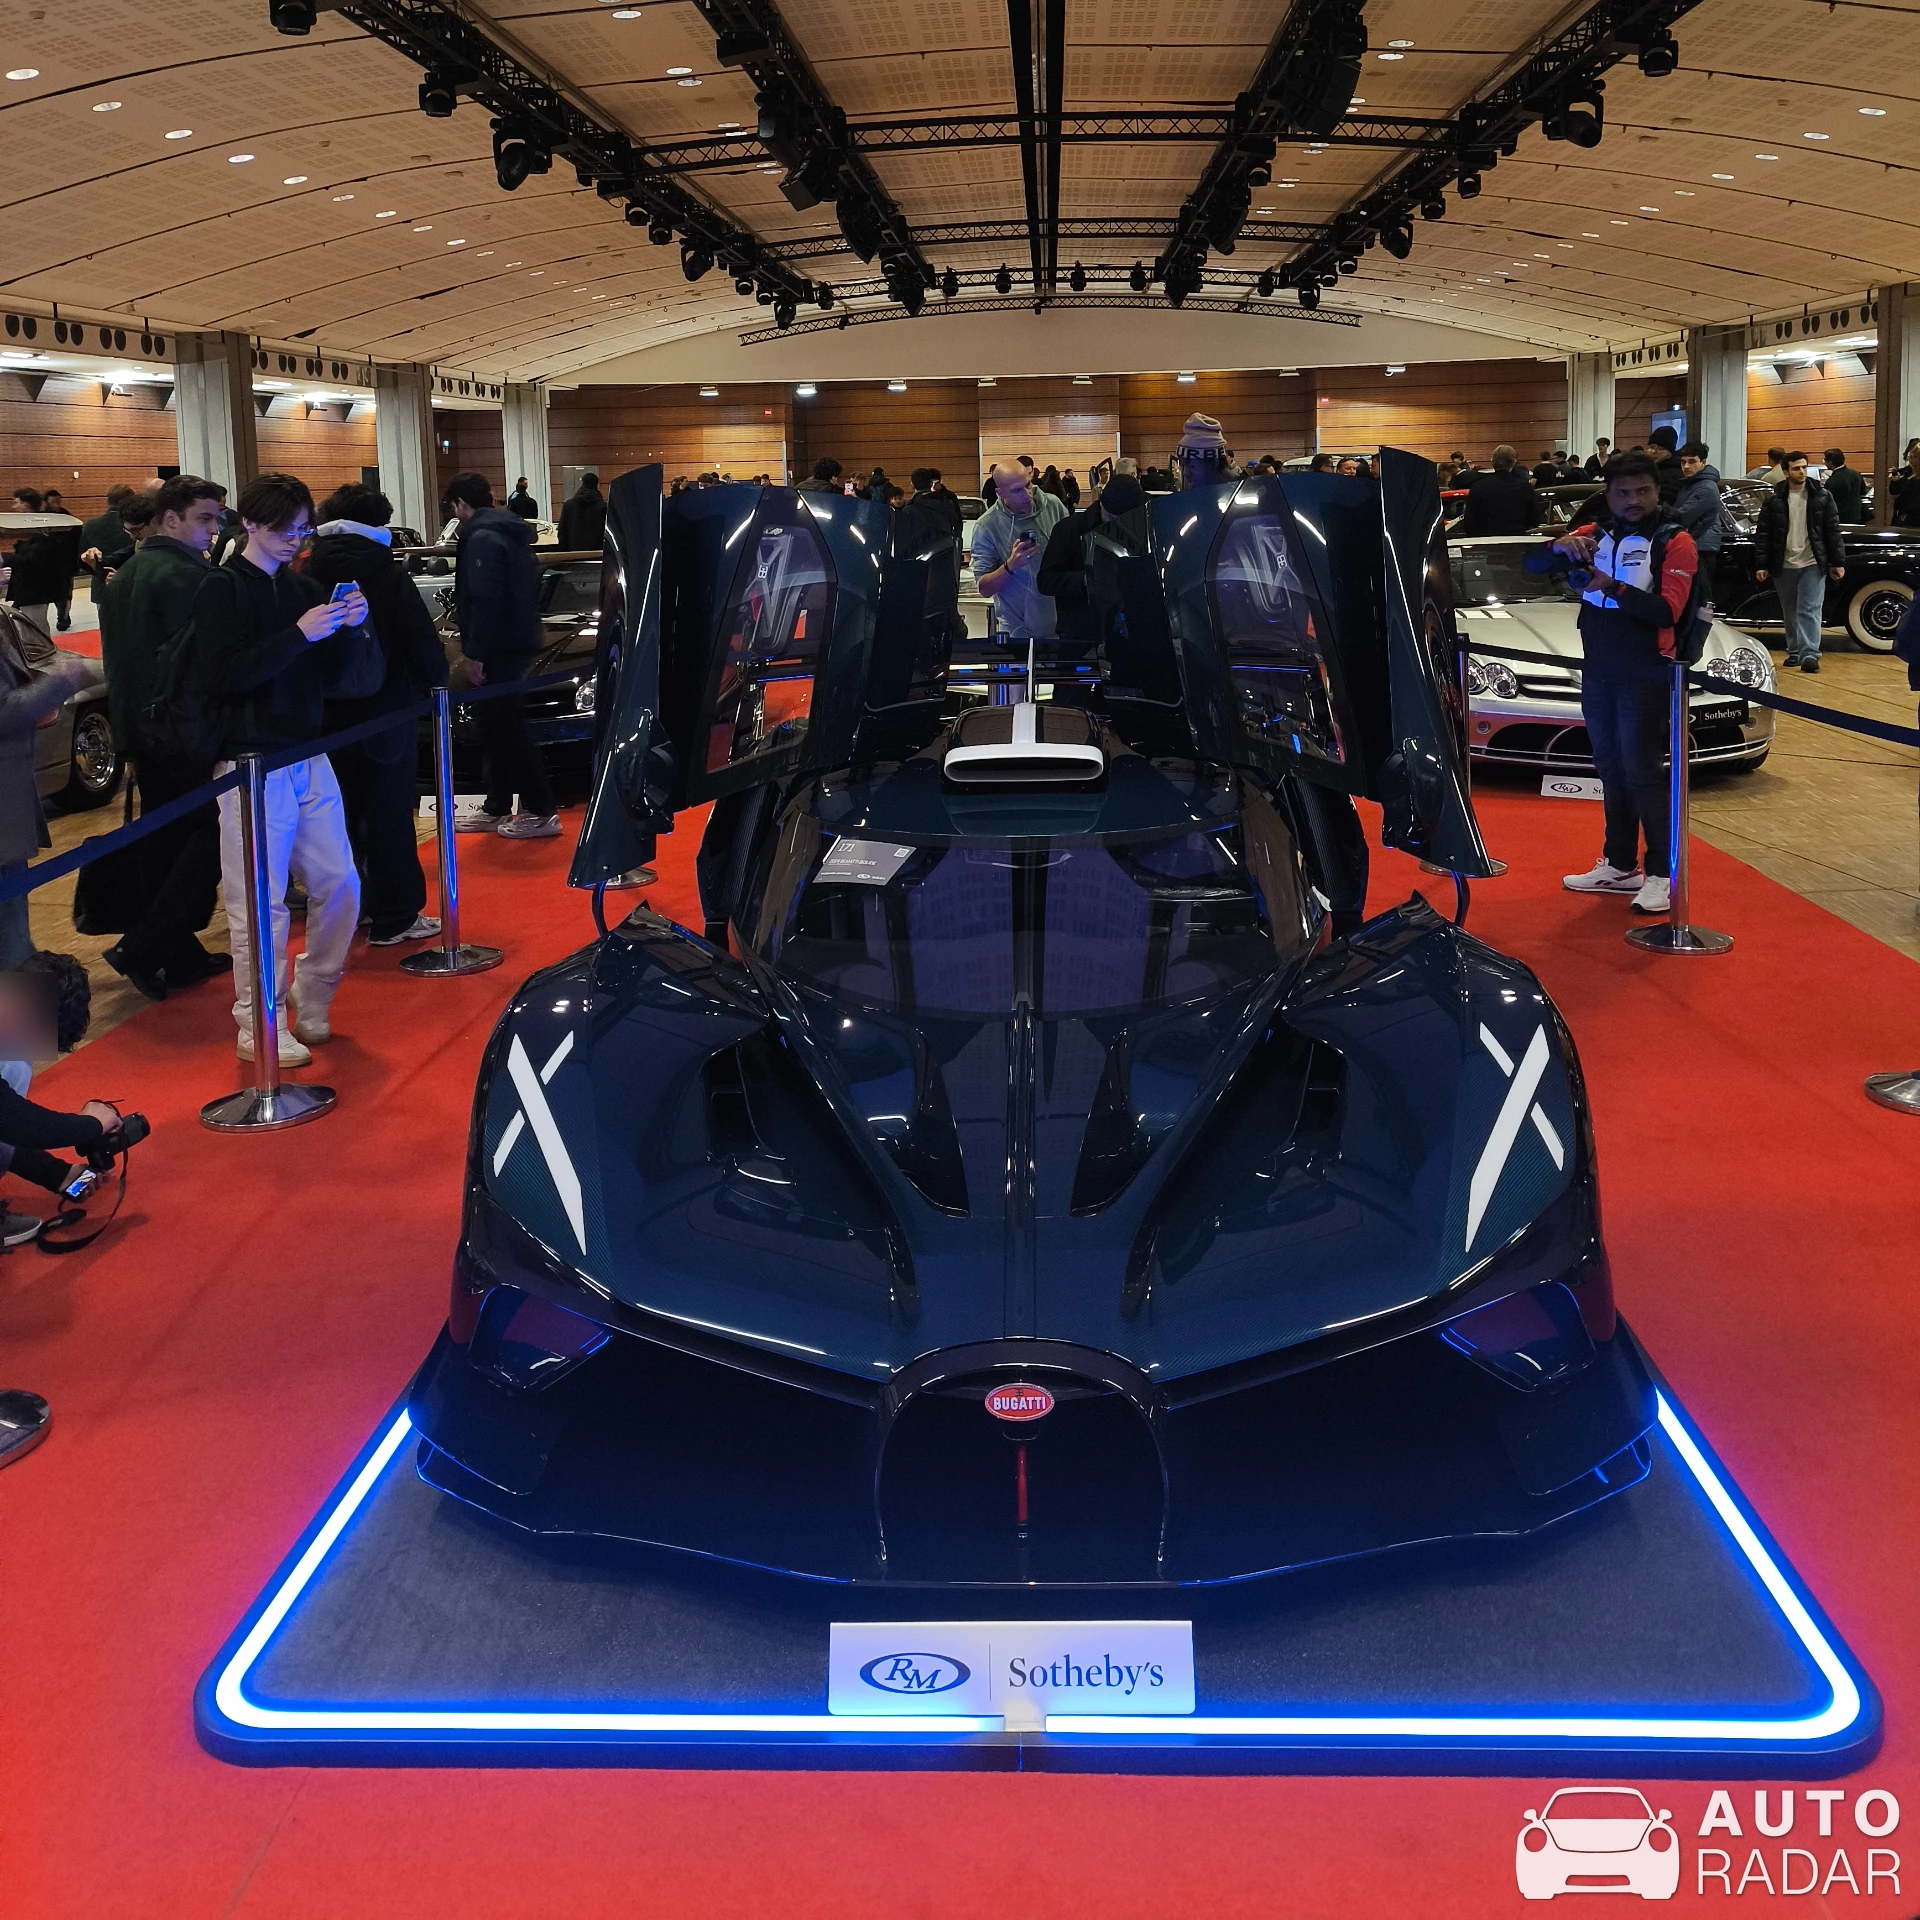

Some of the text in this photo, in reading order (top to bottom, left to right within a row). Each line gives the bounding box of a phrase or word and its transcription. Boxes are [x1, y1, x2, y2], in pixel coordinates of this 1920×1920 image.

[1704, 708, 1742, 721] Sotheby's
[1558, 783, 1575, 794] RM
[837, 843, 856, 853] 171
[993, 1396, 1046, 1411] BUGATTI
[884, 1653, 1165, 1696] RM Sotheby's
